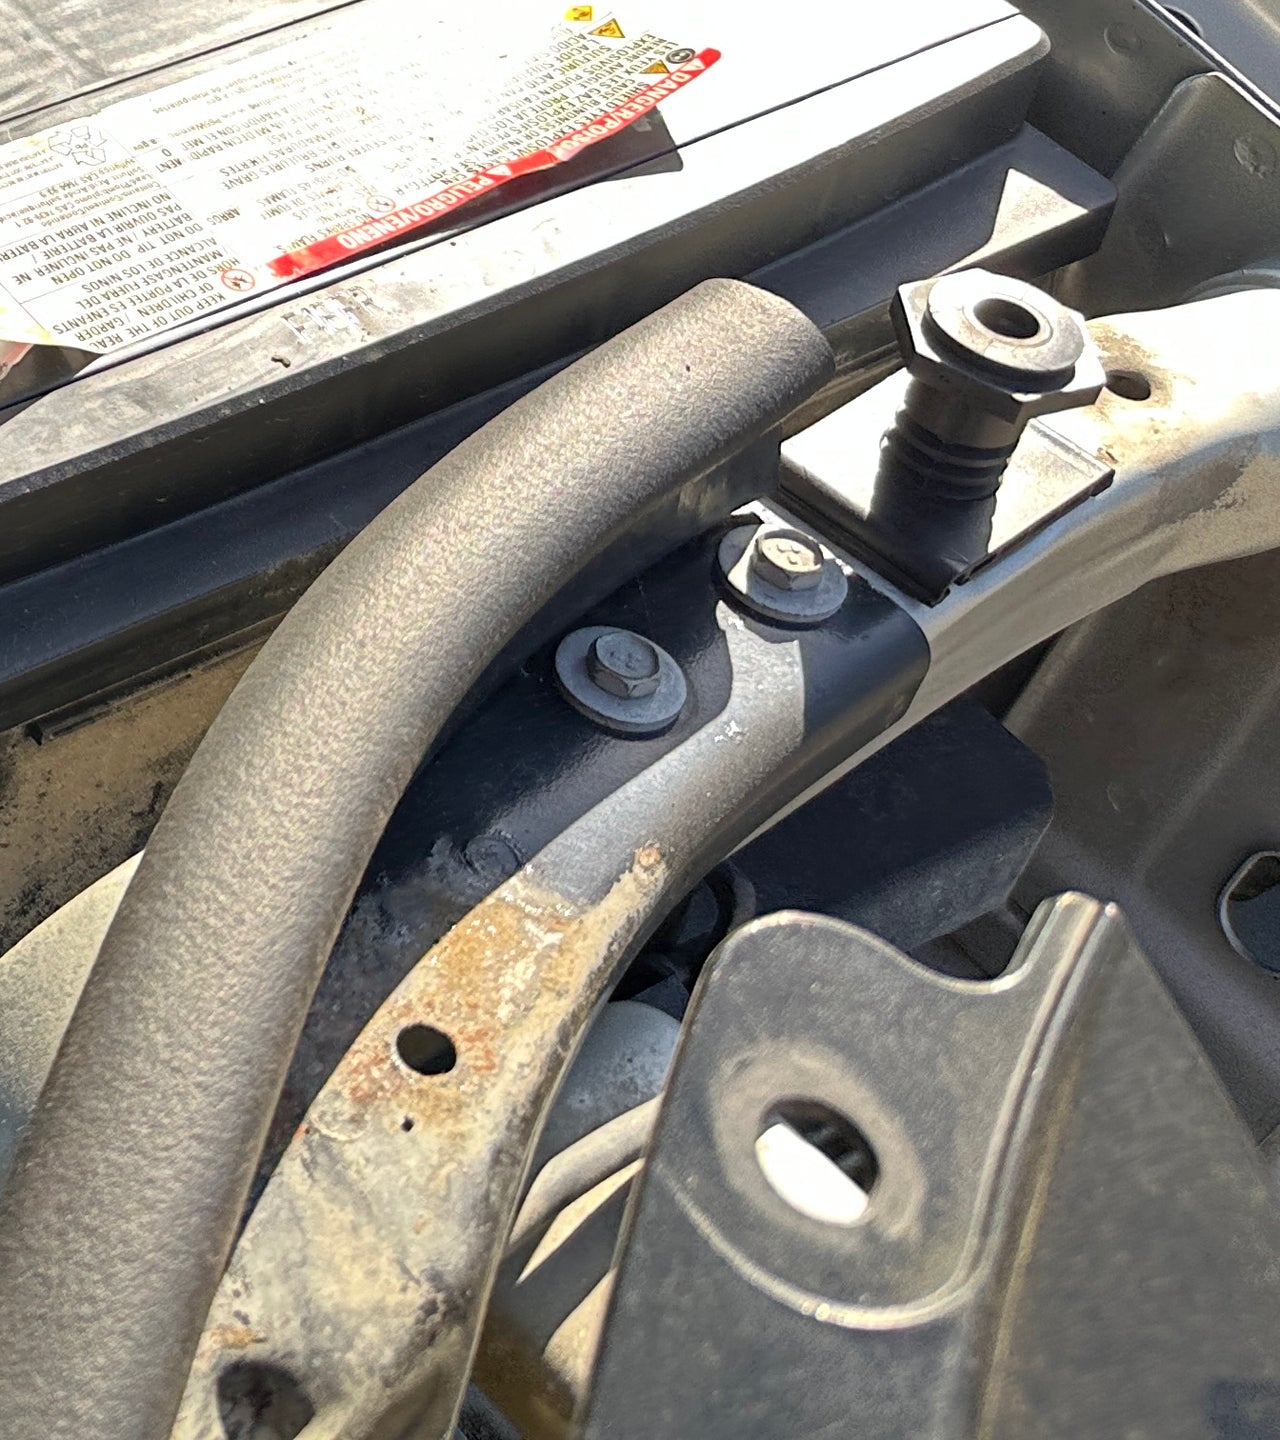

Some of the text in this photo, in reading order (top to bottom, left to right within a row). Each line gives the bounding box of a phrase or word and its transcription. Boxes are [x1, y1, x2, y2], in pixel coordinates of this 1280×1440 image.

[571, 86, 601, 104] GAZ
[149, 191, 172, 205] NO
[103, 198, 153, 222] INCLINE
[154, 201, 182, 217] PAS
[333, 172, 493, 250] PELIGRO/VENENO
[110, 210, 158, 233] OUVRIR
[138, 211, 193, 237] BATTERY
[36, 234, 57, 247] LA
[94, 226, 114, 239] LA
[112, 234, 134, 247] NE
[38, 233, 98, 260] BATTERIE
[48, 221, 204, 285] DO NOT TIP DO NOT OPEN
[87, 241, 115, 256] PAS
[161, 235, 219, 263] ALCANCE
[32, 250, 91, 277] INCLINER
[120, 262, 148, 279] LOS
[137, 248, 224, 287] MANTENGASE
[144, 256, 165, 269] DE
[10, 271, 33, 285] NE
[170, 276, 190, 289] LA
[187, 268, 208, 282] DE
[98, 279, 141, 301] FUERA
[194, 281, 215, 294] OF
[74, 294, 102, 310] DEL
[134, 287, 198, 317] CHILDREN
[191, 291, 227, 310] KEEP
[50, 306, 111, 335] ENFANTS
[166, 304, 195, 321] OUT
[72, 316, 126, 342] GARDER
[124, 322, 151, 337] THE
[148, 315, 169, 328] OF
